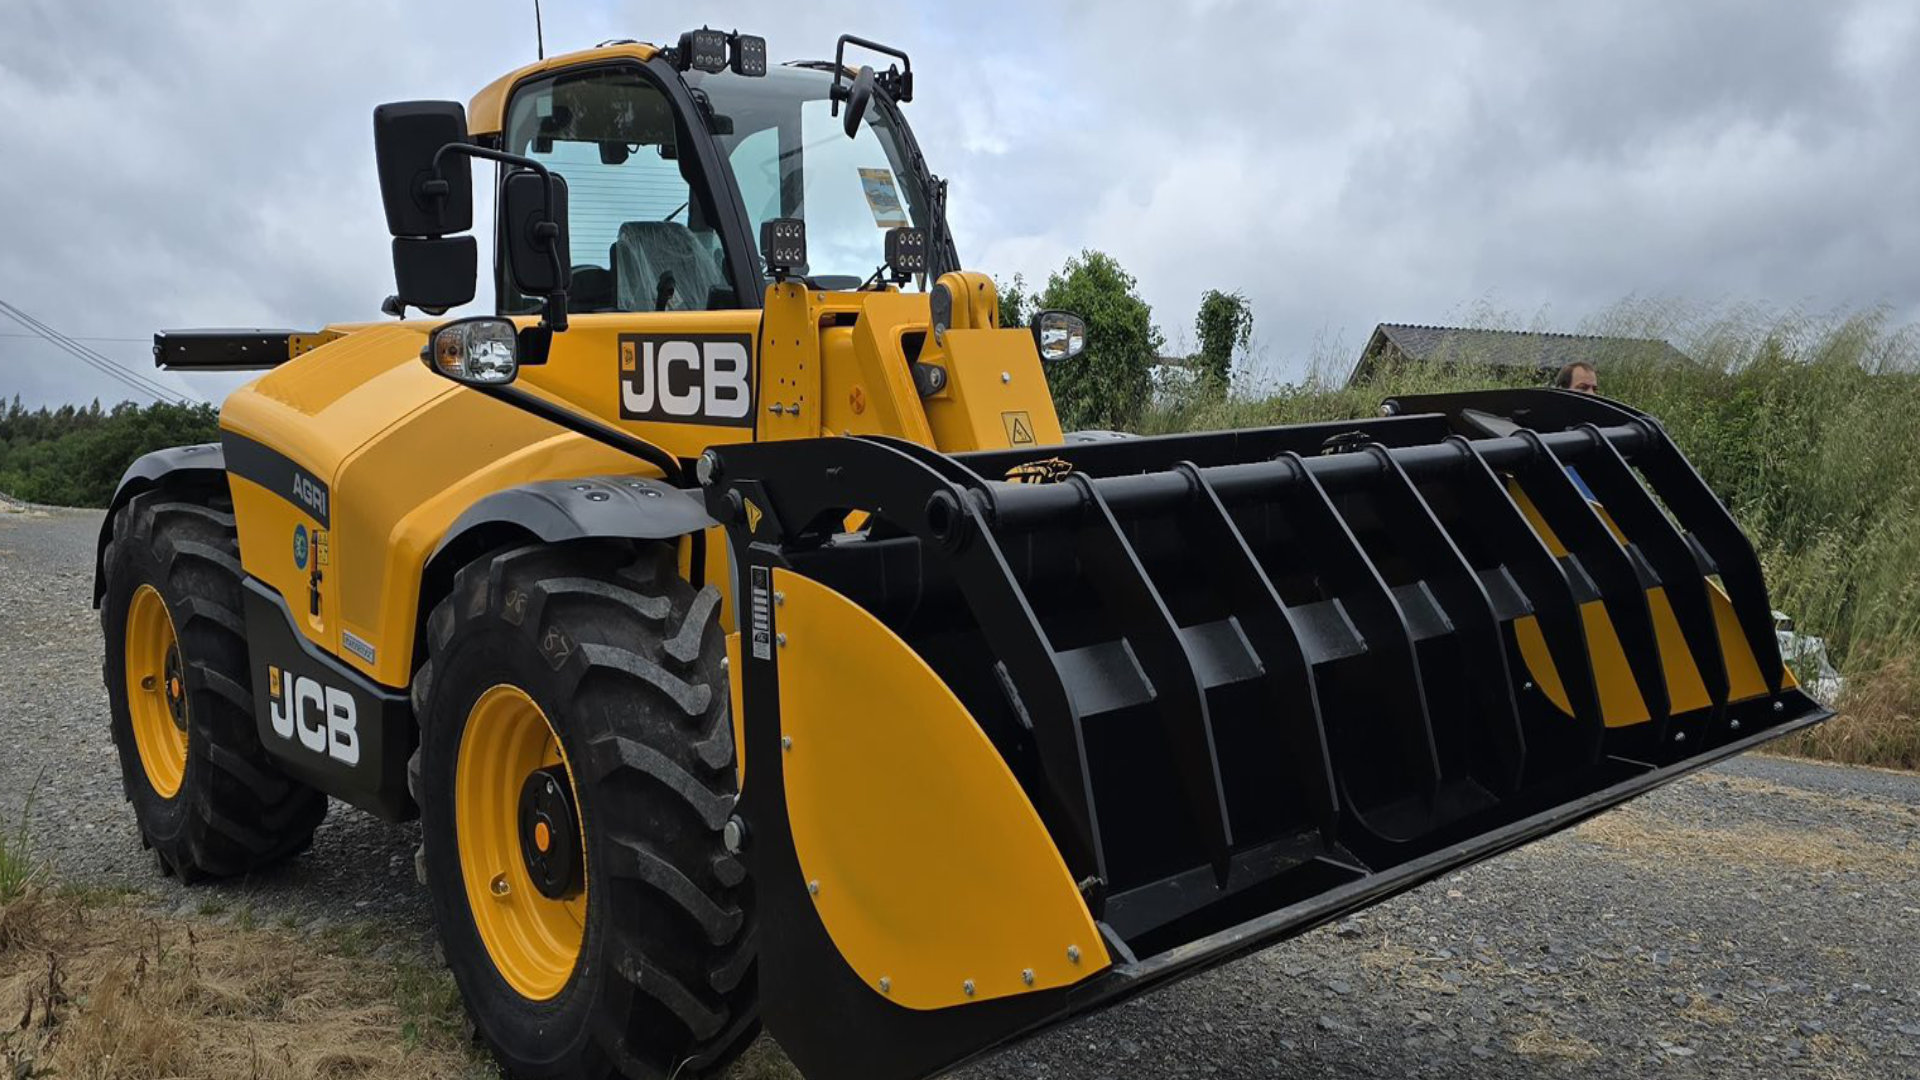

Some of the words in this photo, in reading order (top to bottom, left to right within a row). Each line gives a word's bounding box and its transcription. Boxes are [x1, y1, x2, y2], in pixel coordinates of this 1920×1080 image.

[622, 341, 750, 418] JCB
[293, 472, 326, 517] AGRI
[269, 670, 360, 767] JCB
